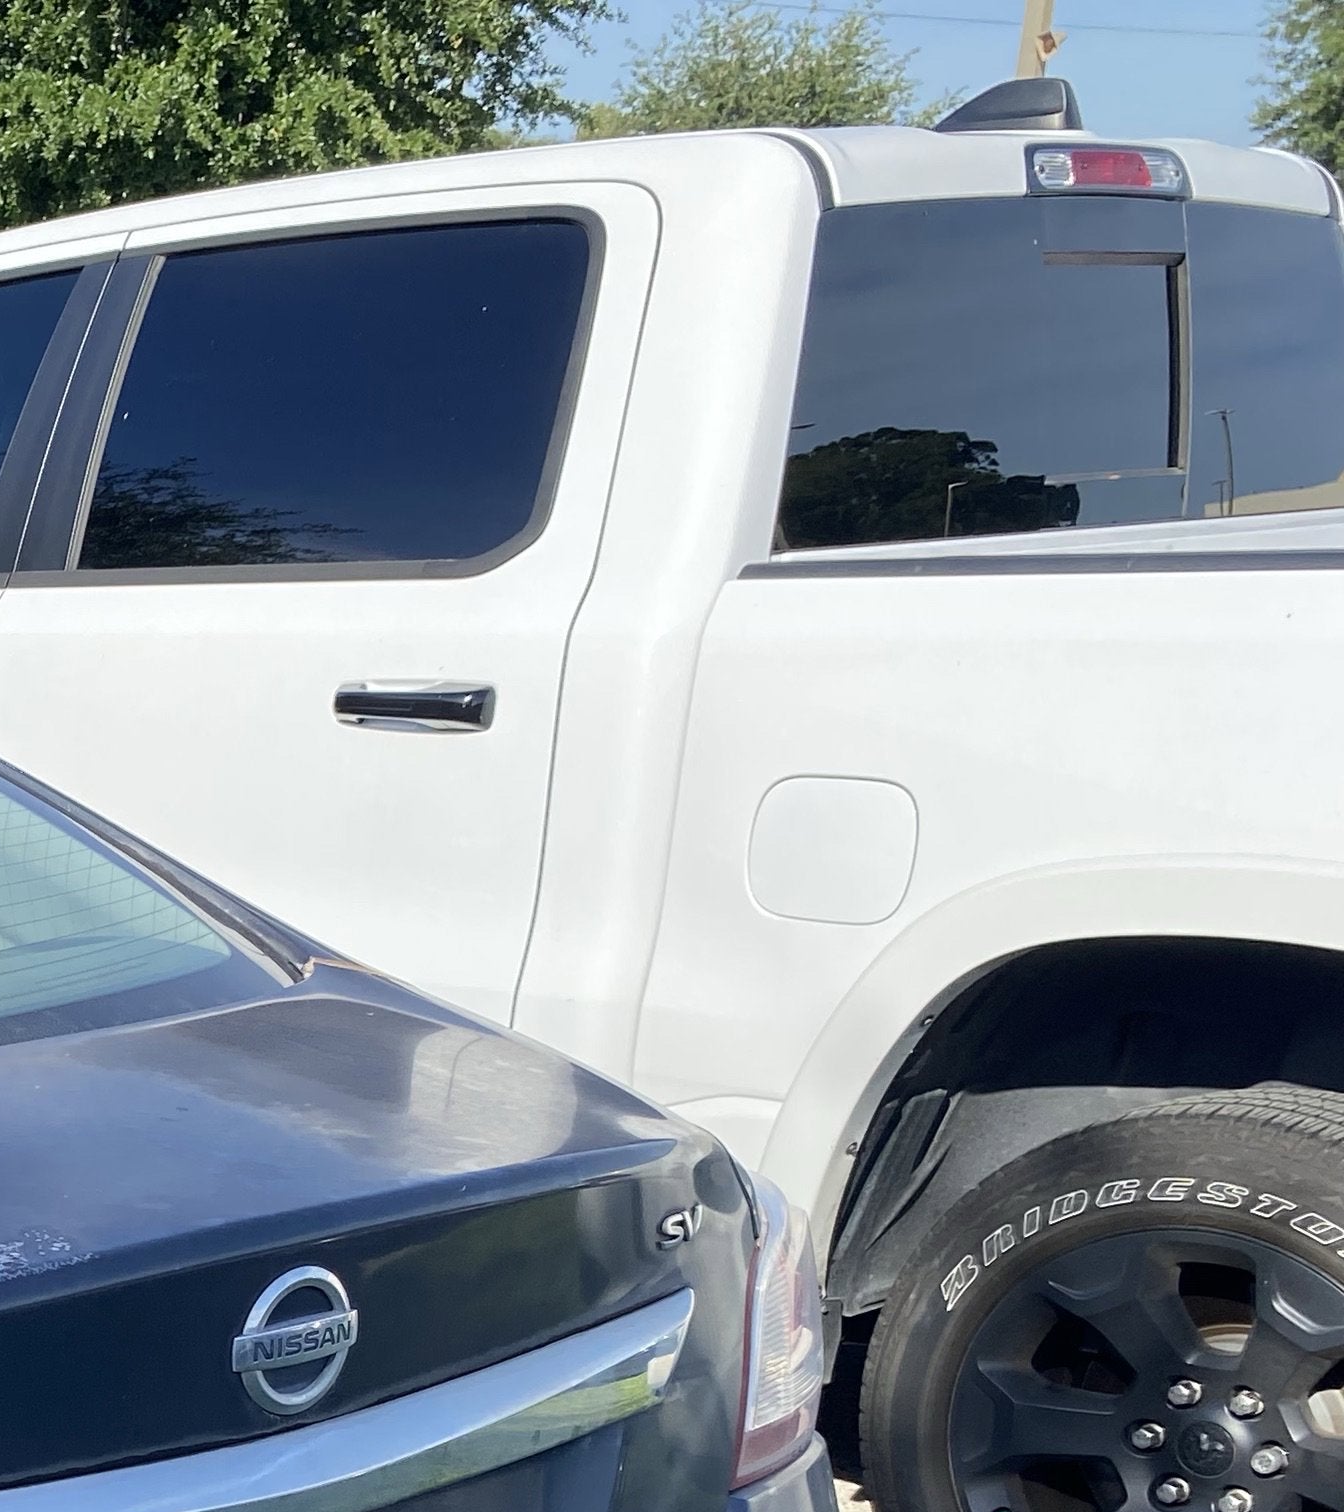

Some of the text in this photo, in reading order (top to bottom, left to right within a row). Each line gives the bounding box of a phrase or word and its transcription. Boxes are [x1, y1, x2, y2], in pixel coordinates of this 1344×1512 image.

[655, 1202, 703, 1250] SV
[939, 1176, 1344, 1313] BRIDGESTO
[252, 1320, 352, 1363] NISSAN
